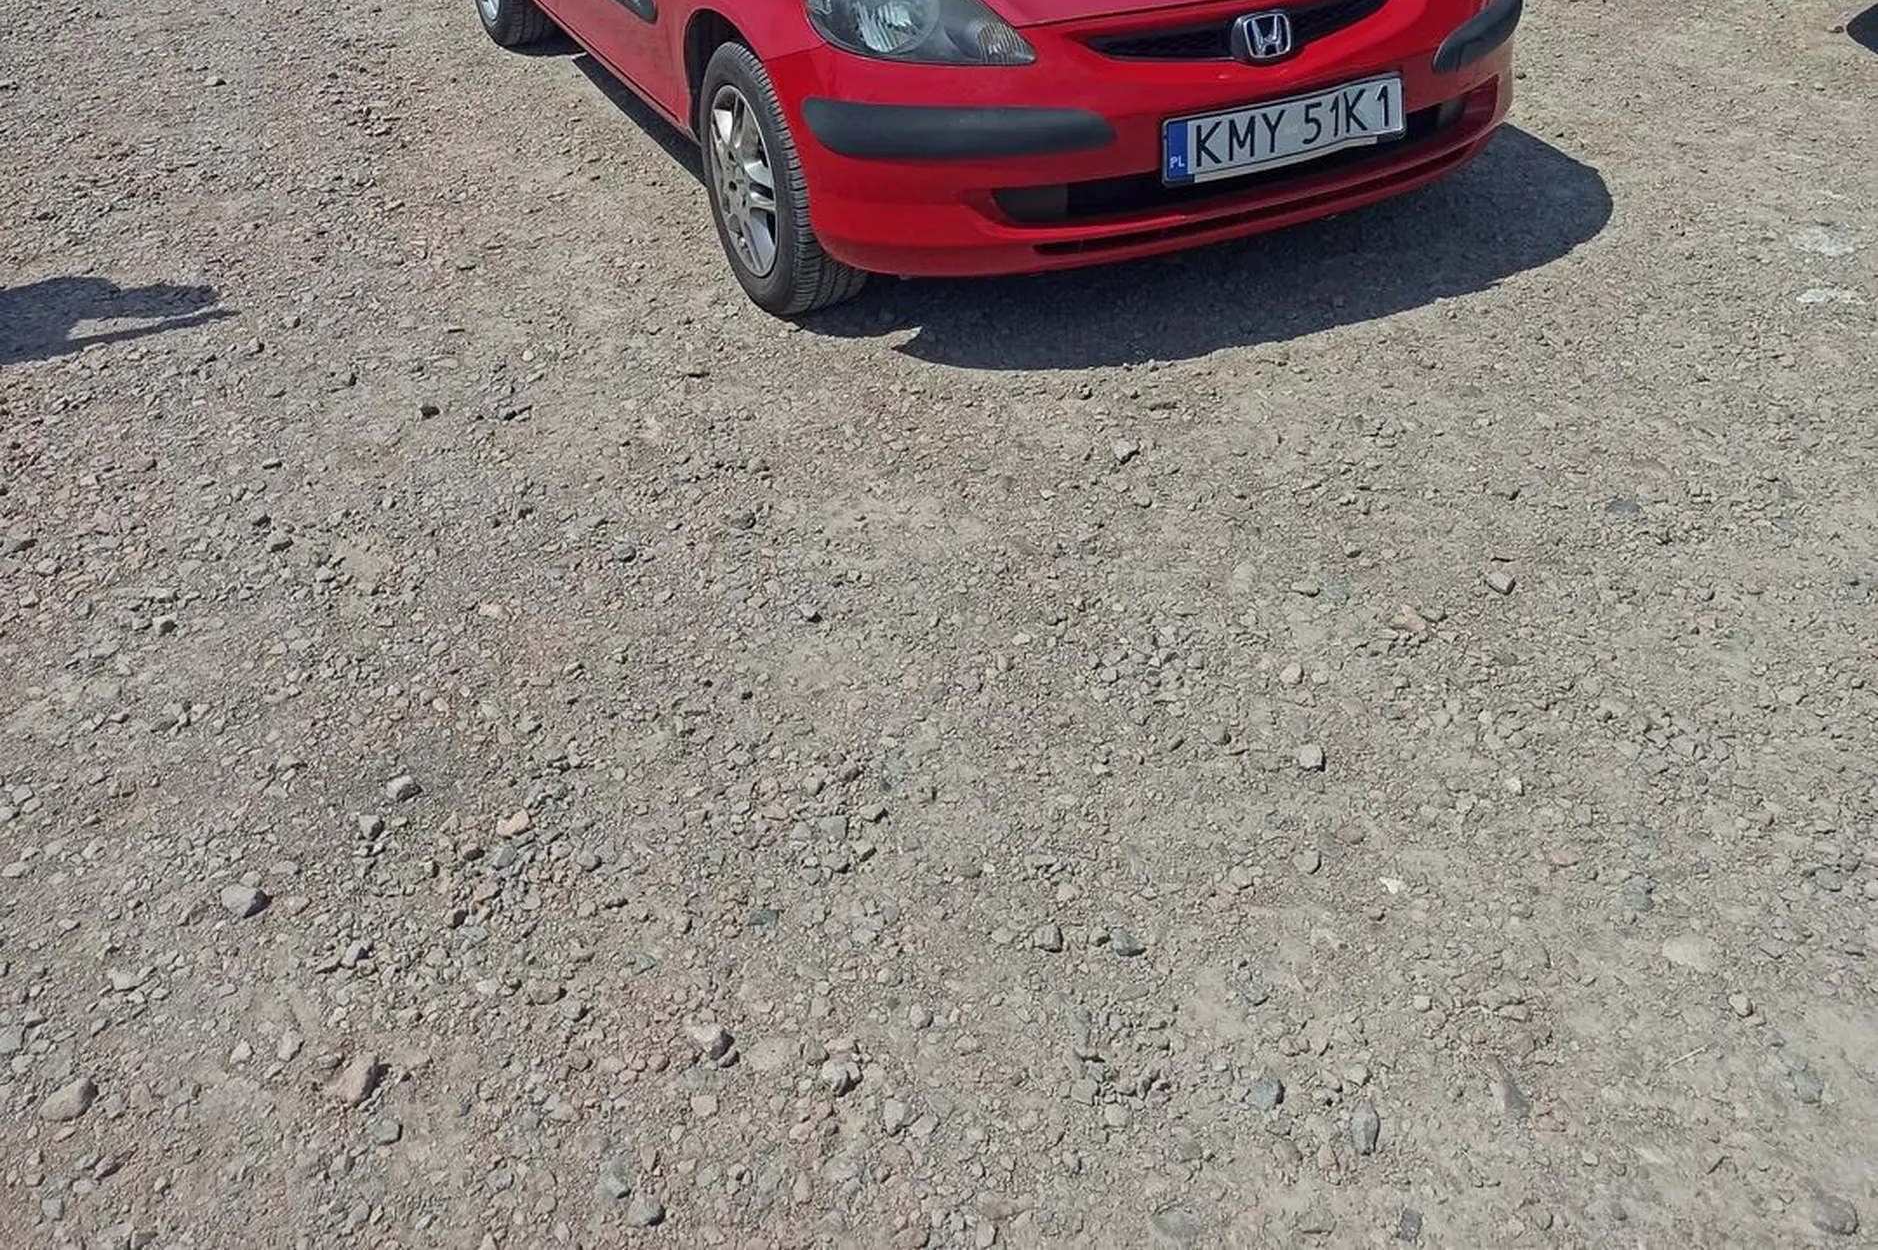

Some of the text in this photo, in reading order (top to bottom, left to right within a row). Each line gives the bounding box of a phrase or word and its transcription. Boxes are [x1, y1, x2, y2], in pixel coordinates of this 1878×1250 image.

[1196, 85, 1389, 167] KMY 51K1
[1169, 156, 1185, 169] PL
